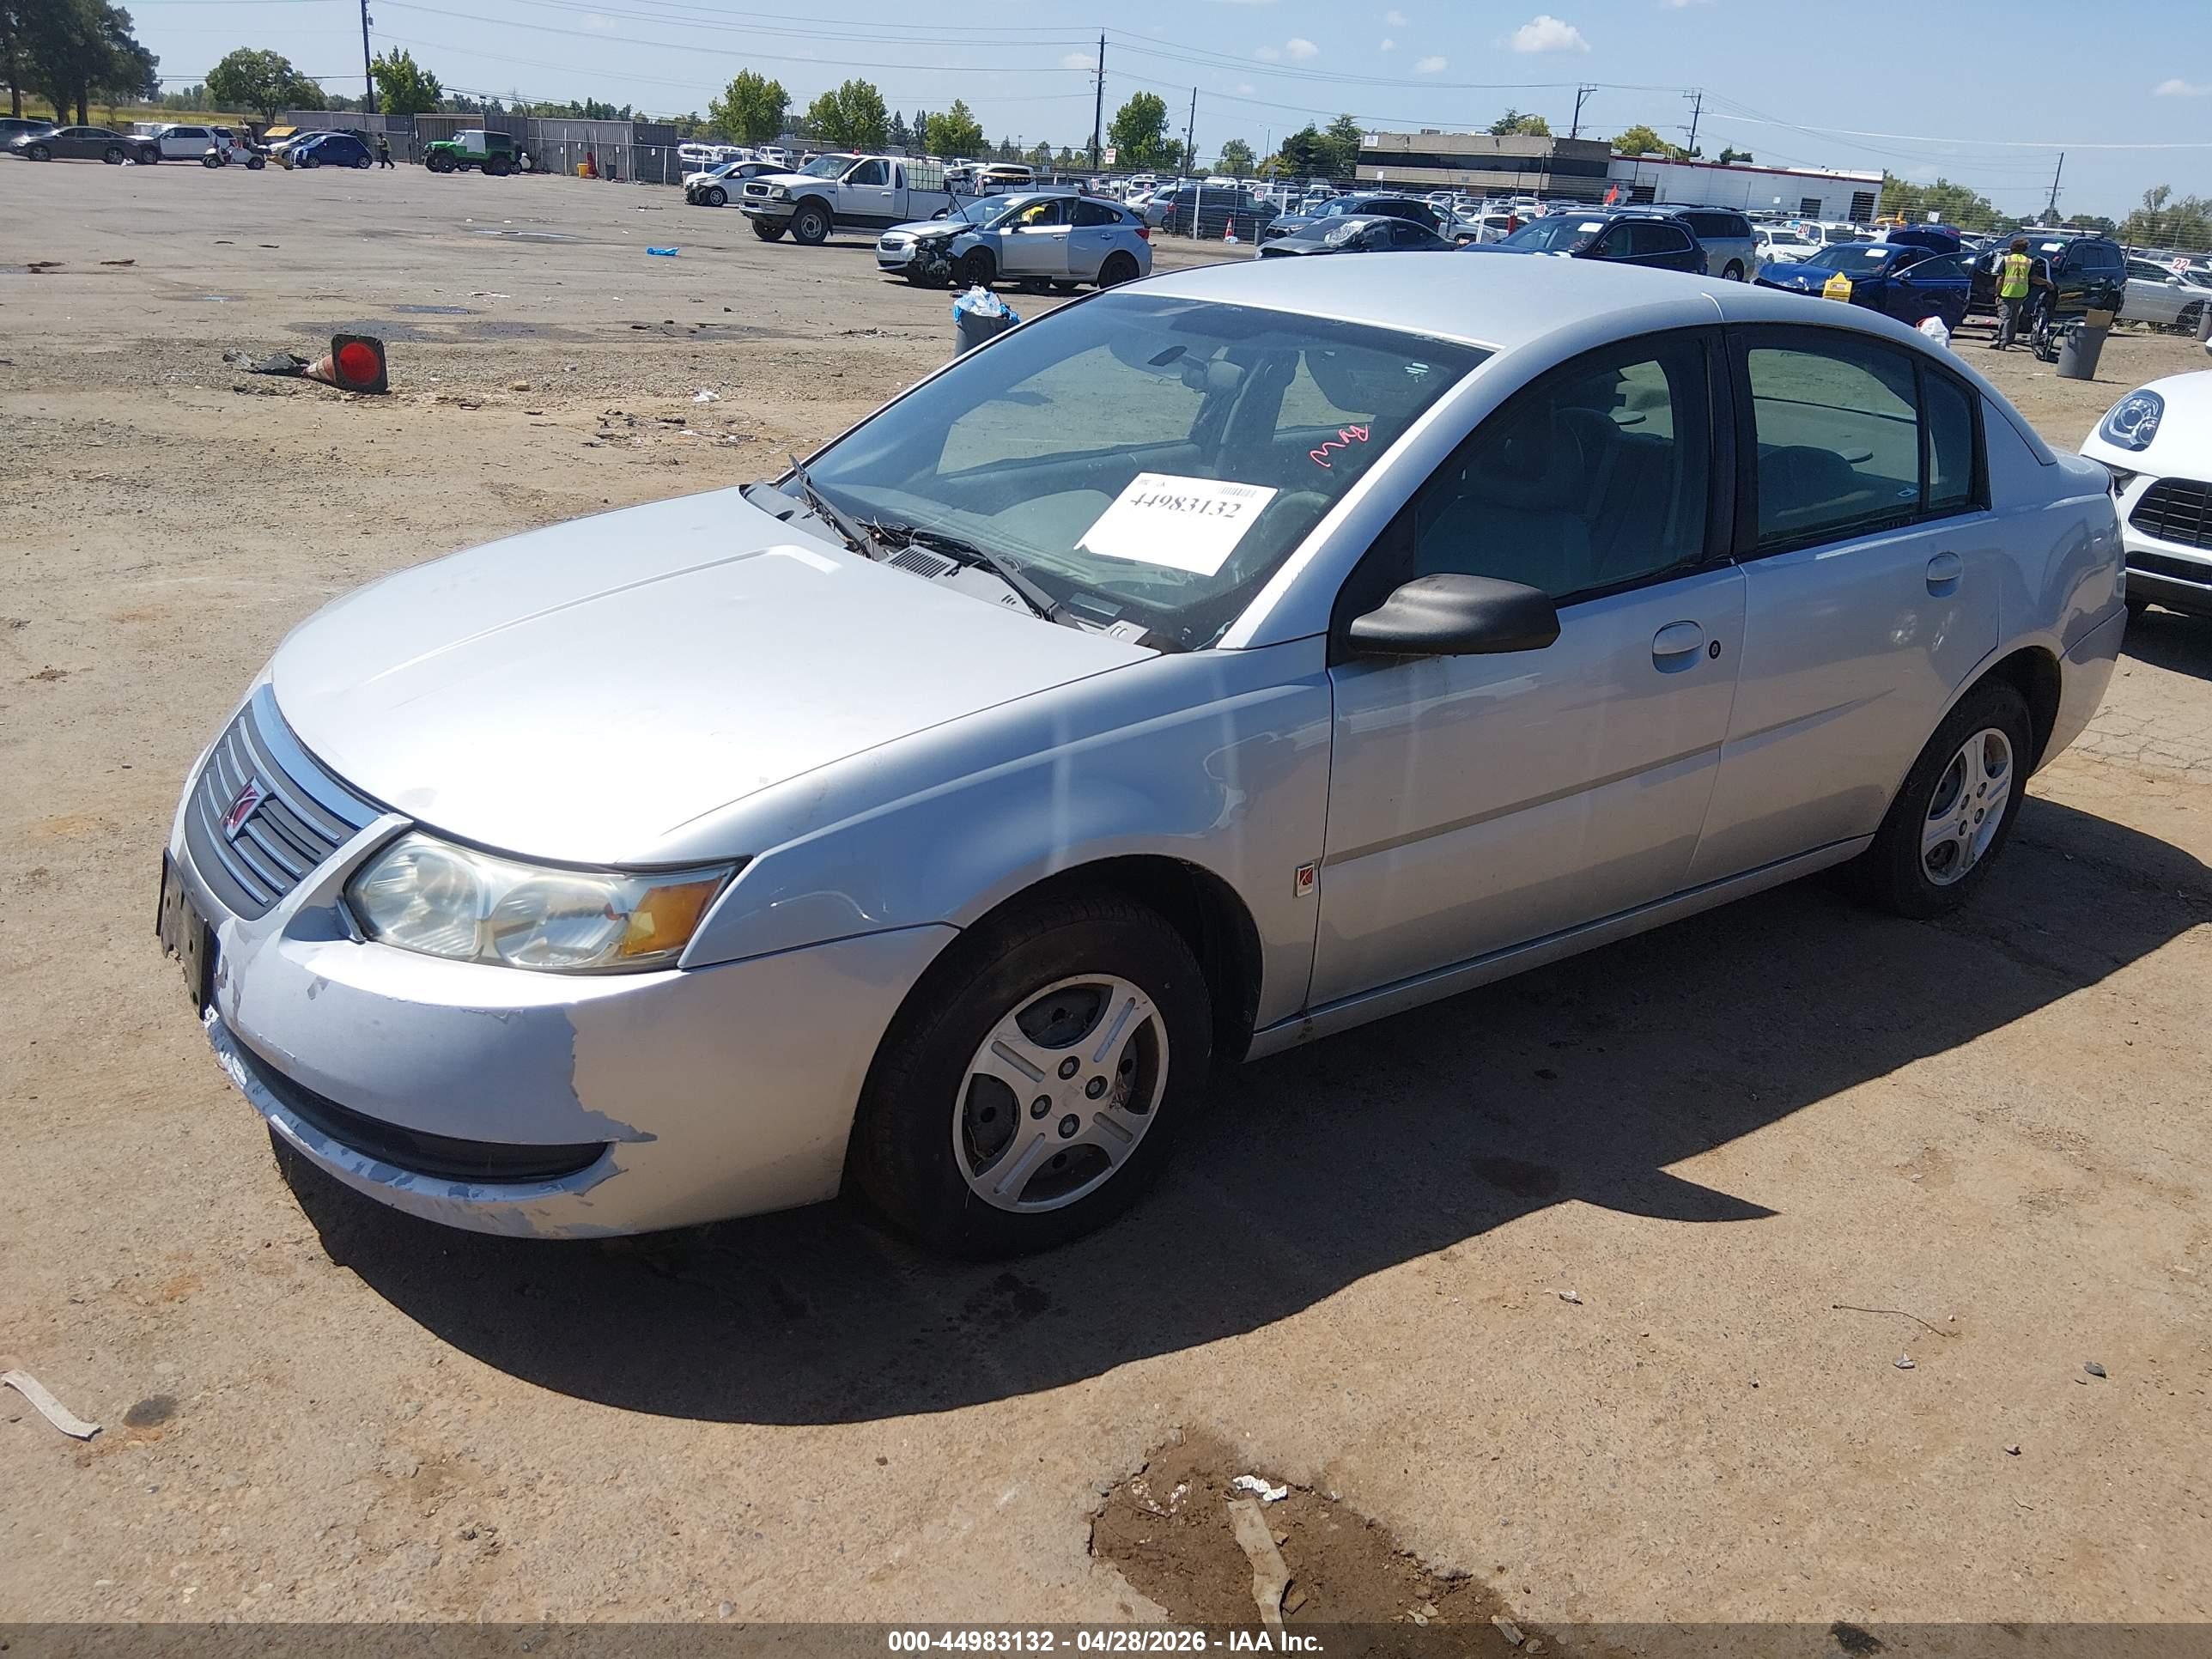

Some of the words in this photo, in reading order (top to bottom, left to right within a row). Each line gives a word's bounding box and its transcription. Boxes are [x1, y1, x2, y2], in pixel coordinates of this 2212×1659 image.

[1537, 205, 1545, 214] 18
[1798, 224, 1808, 234] 20
[2172, 258, 2188, 270] 22
[1129, 493, 1242, 519] 44983132
